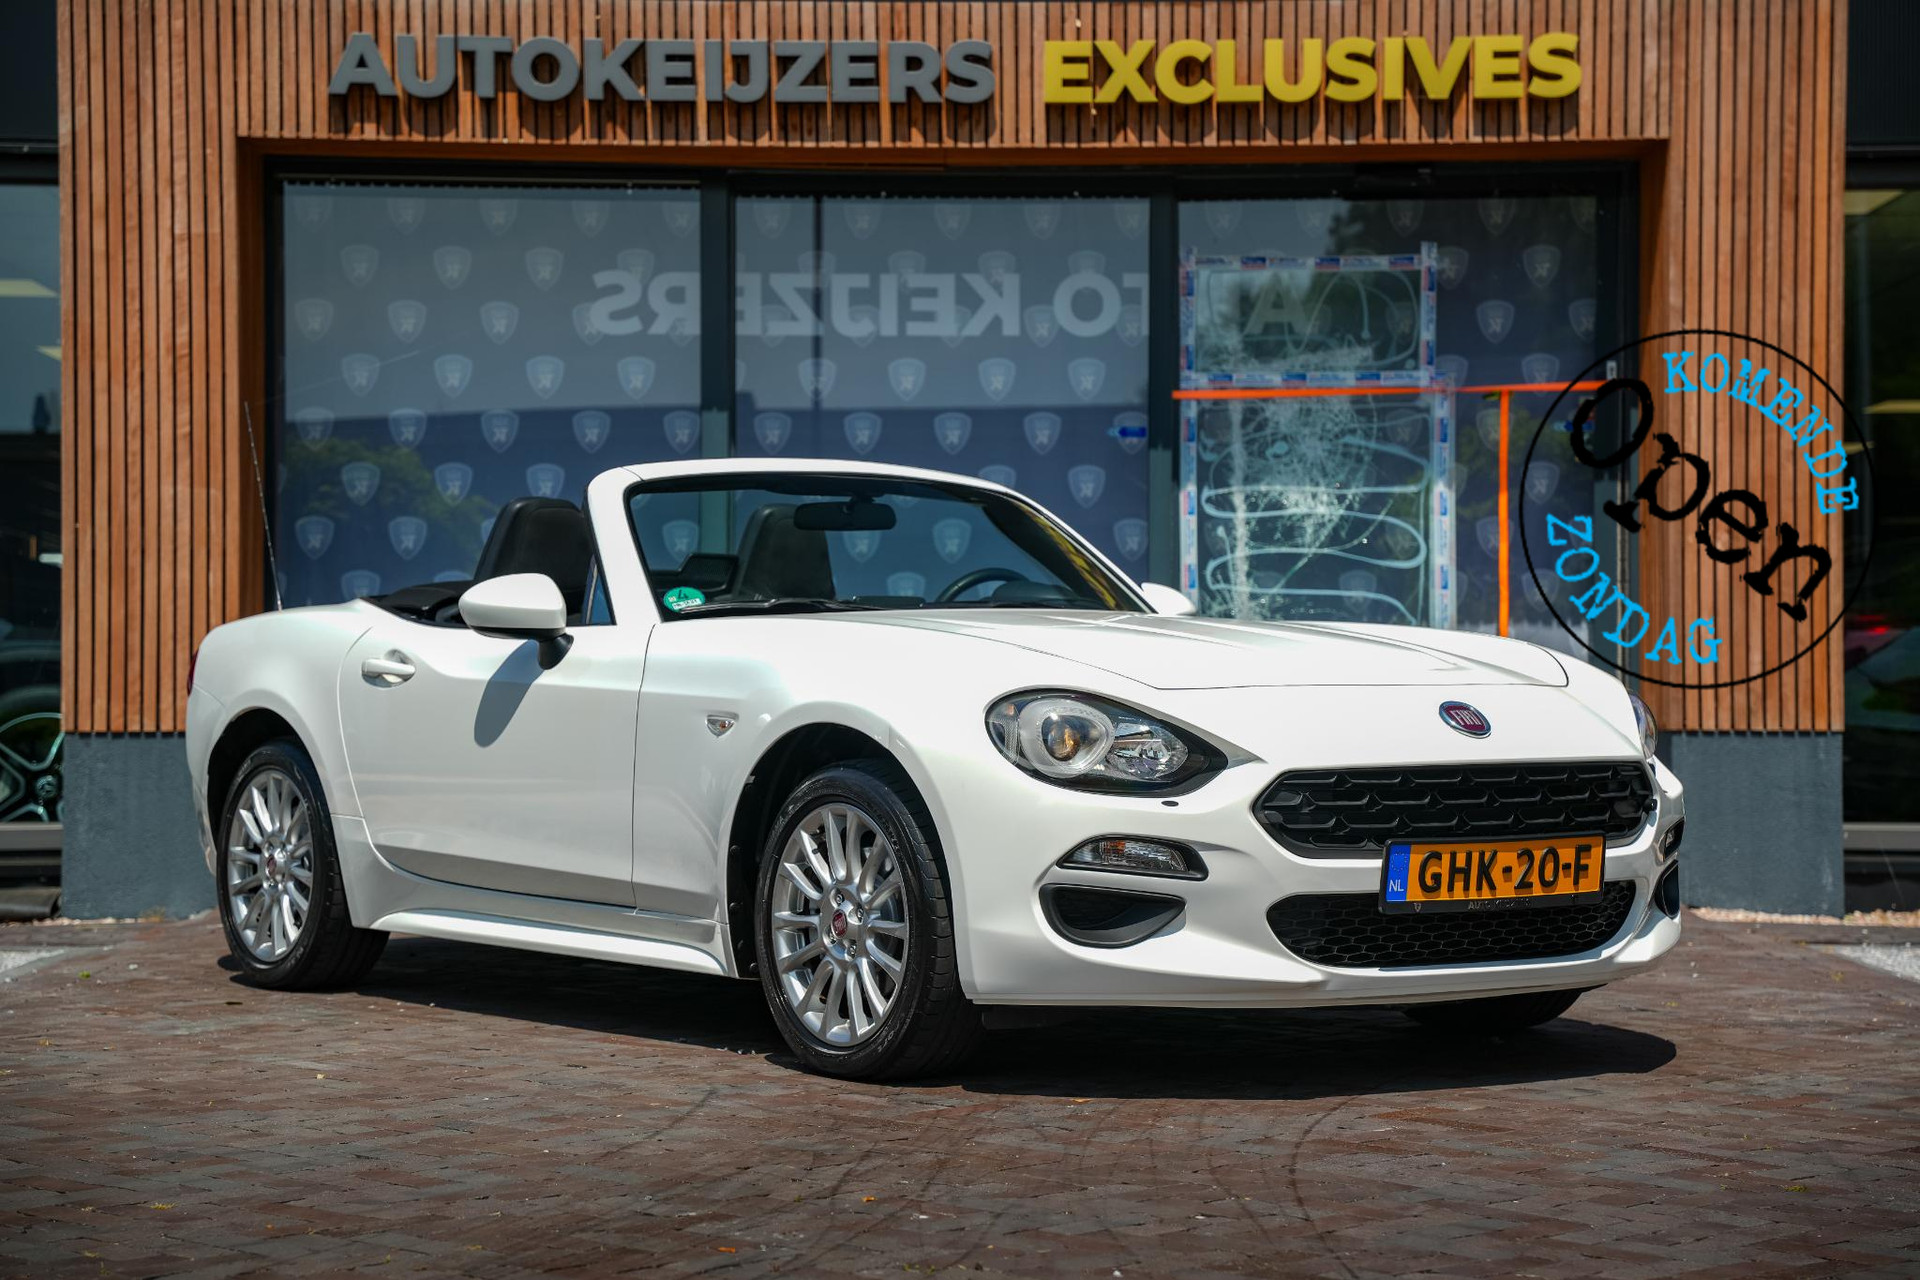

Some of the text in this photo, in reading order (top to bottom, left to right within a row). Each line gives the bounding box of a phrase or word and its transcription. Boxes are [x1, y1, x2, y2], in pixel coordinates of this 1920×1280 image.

[329, 31, 1583, 104] AUTOKEIJZERS EXCLUSIVES
[1449, 708, 1483, 726] FIAT
[1388, 879, 1405, 893] NL
[1418, 844, 1592, 894] GHK-20-F
